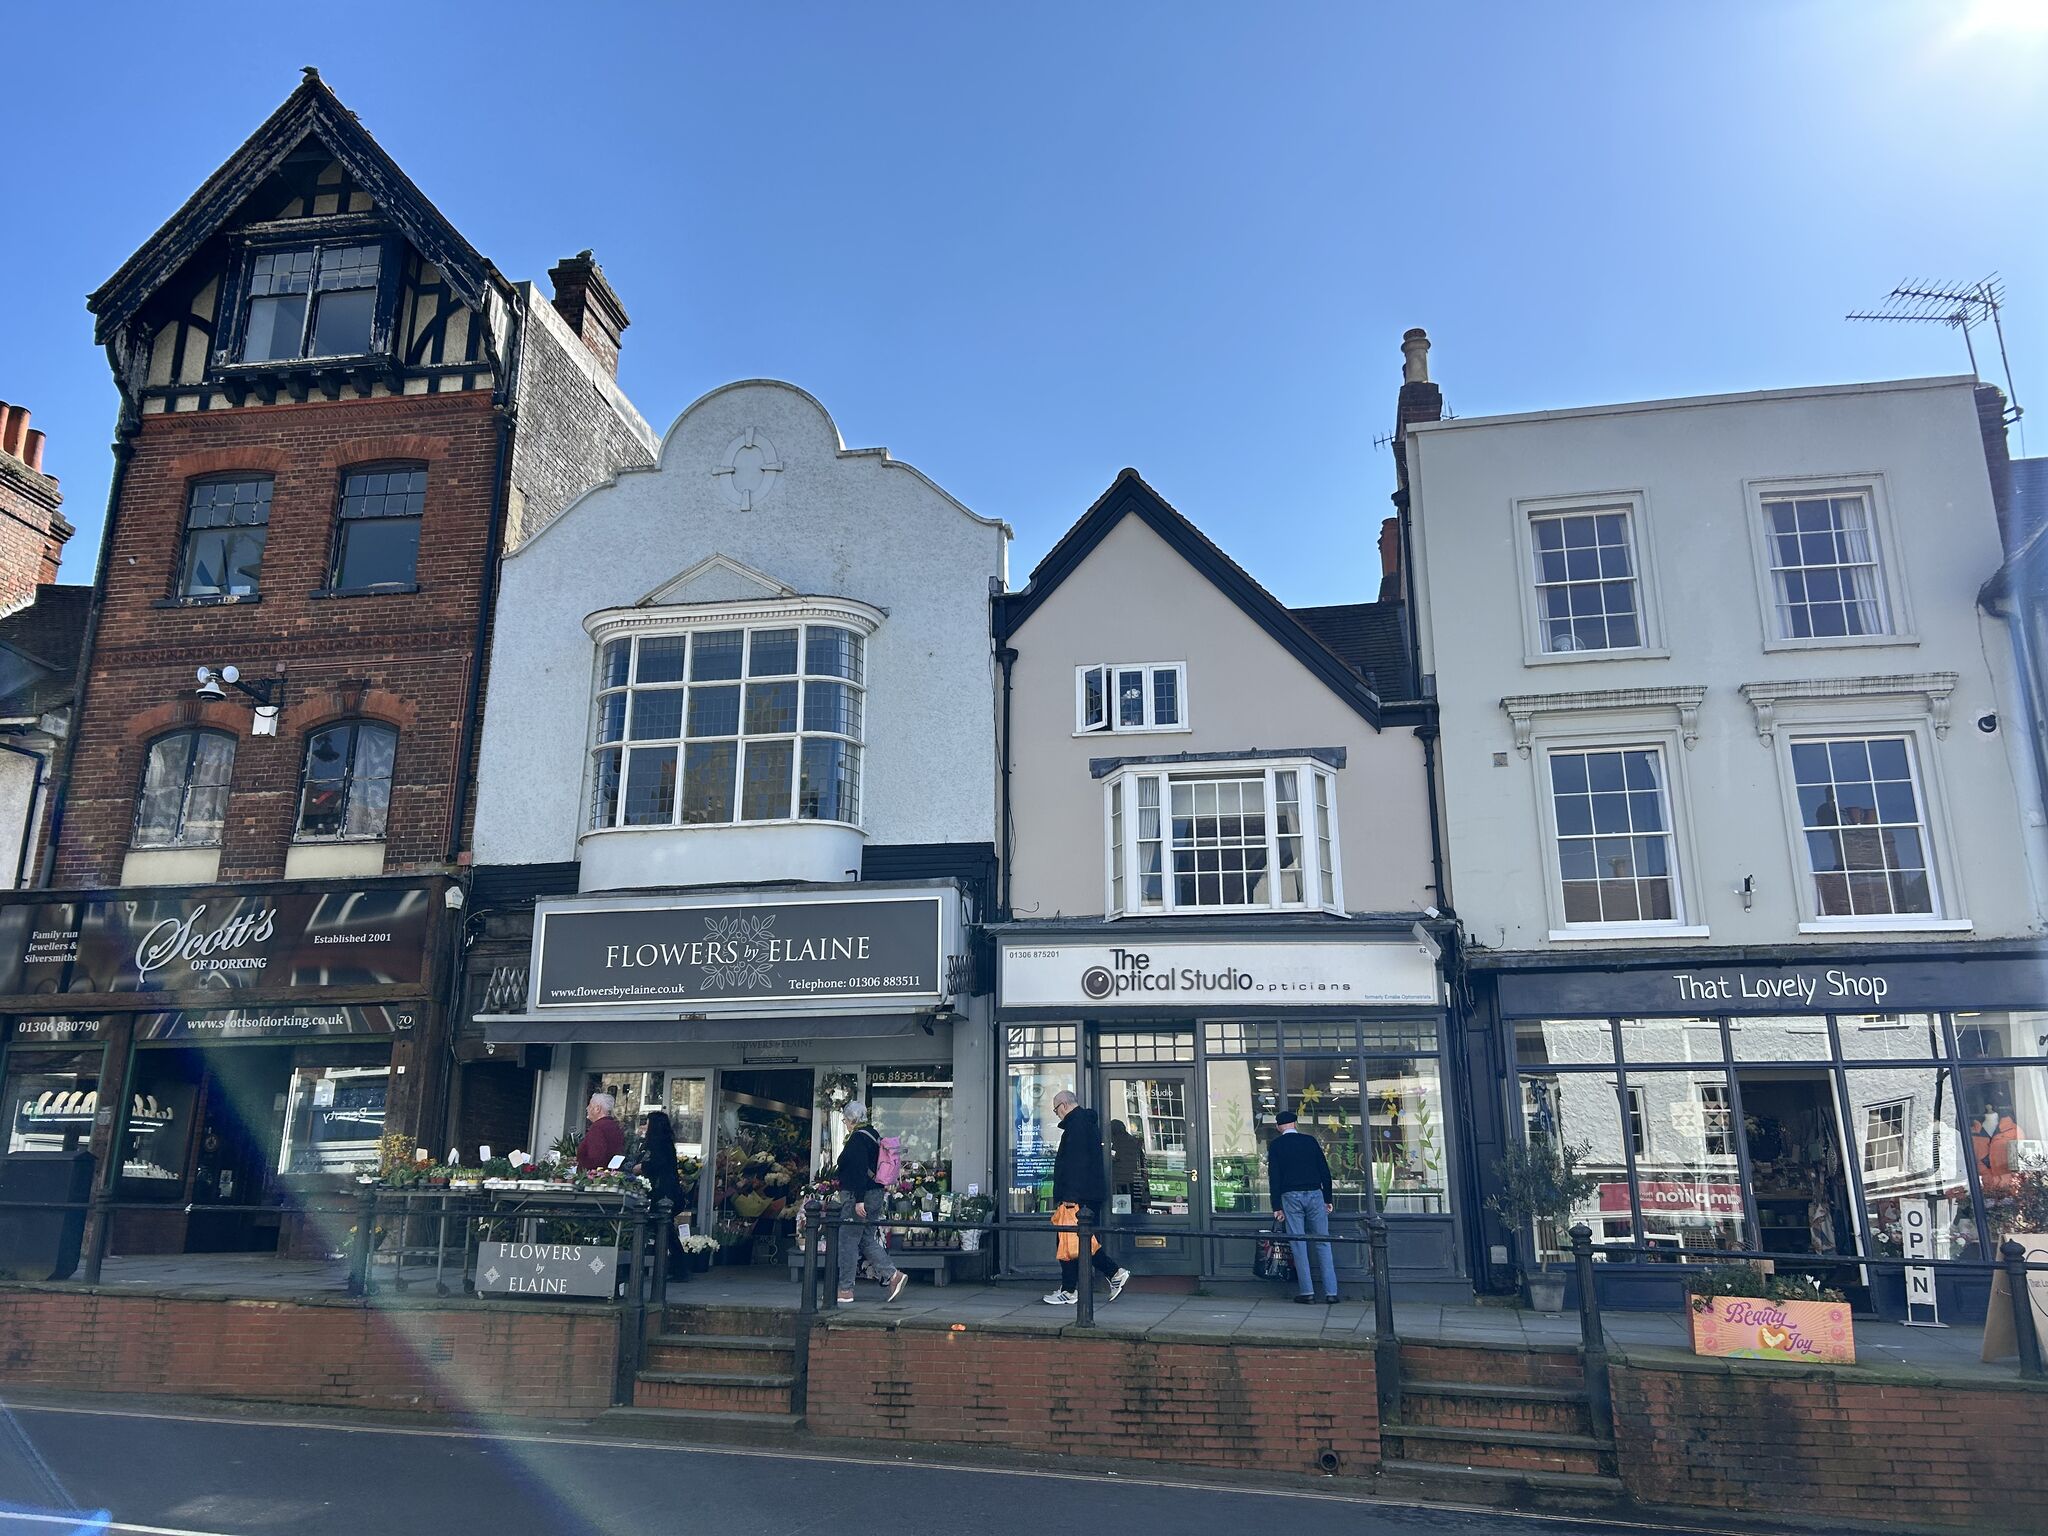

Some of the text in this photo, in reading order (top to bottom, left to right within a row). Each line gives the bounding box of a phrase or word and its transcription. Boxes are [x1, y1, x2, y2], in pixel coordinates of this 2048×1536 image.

[32, 930, 78, 940] Family run
[314, 933, 391, 944] Established 2001
[28, 941, 77, 952] Jewellers &
[135, 904, 277, 984] Scott's
[606, 936, 870, 968] FLOWERS by ELAINE
[24, 953, 78, 963] Silversmiths
[1009, 951, 1032, 959] 01306
[1109, 948, 1150, 970] The
[190, 957, 267, 971] OF DORKING
[789, 975, 920, 992] Telephone: 01306 883511
[1180, 967, 1253, 991] Studio
[1256, 982, 1351, 993] opticians
[1673, 969, 1888, 1006] That Lovely Shop
[551, 983, 685, 999] www.flowersbyelaine.co.uk
[19, 1020, 99, 1033] 01306 880790
[187, 1014, 343, 1030] www.scottsofdorking.co.uk
[399, 1015, 412, 1025] 70
[500, 1243, 581, 1261] FLOWERS
[535, 1263, 545, 1275] by
[508, 1276, 567, 1294] ELAINE
[1724, 1302, 1797, 1329] Beauty
[1784, 1333, 1822, 1354] Joy
